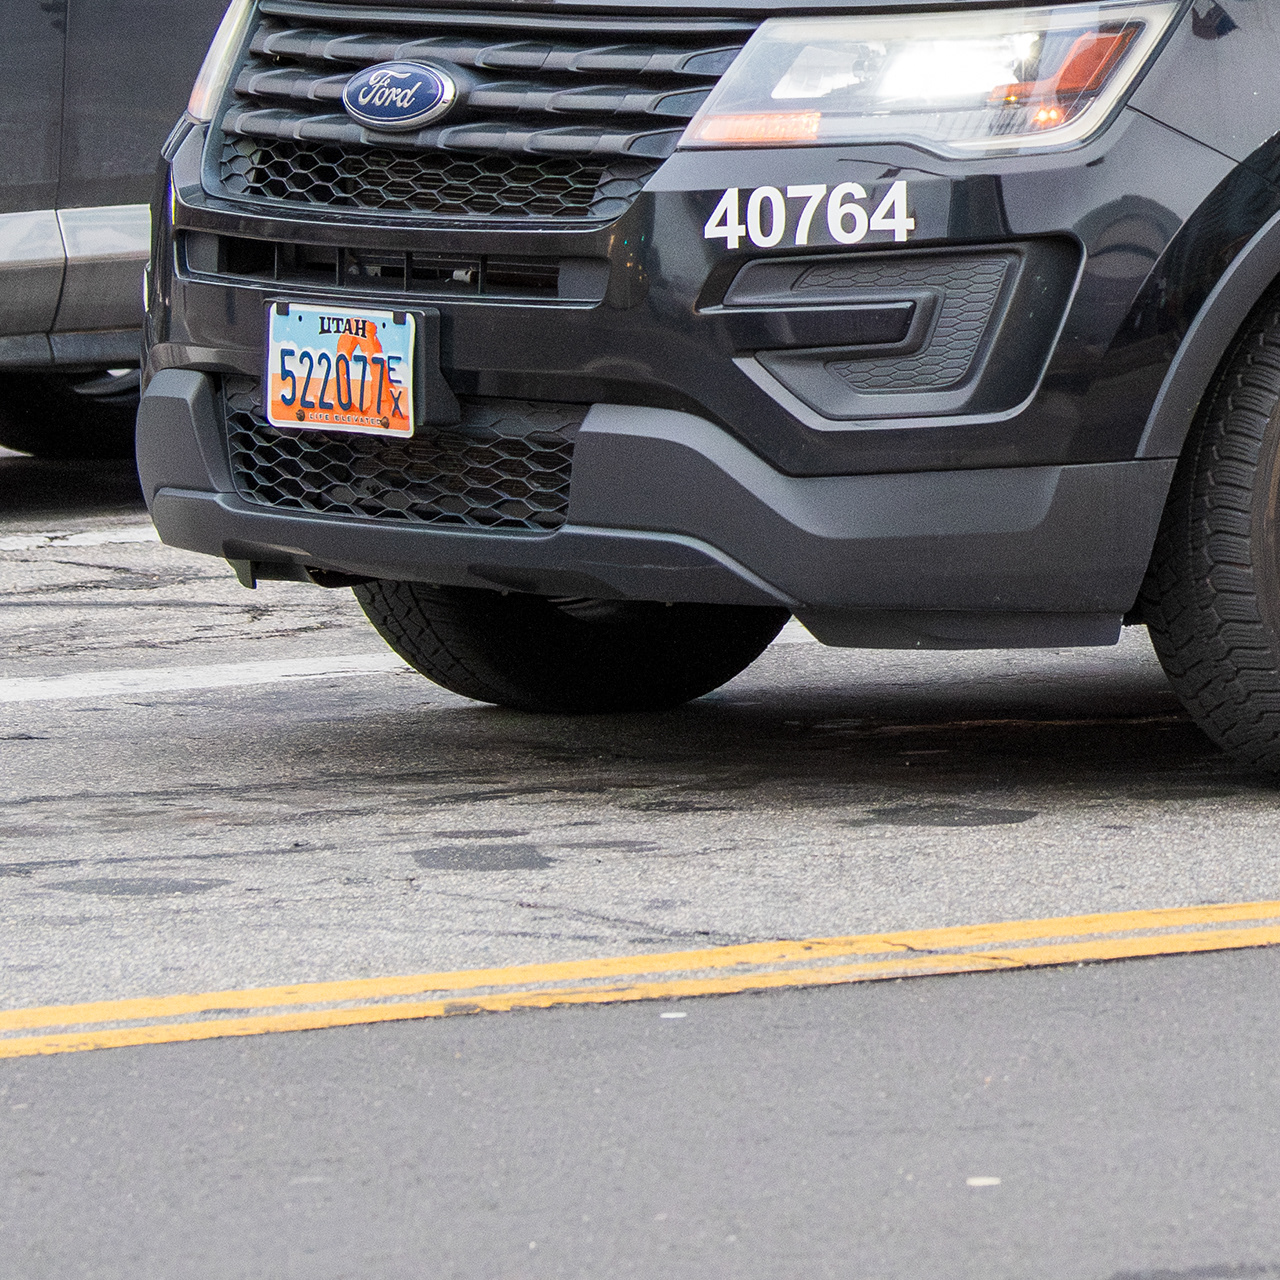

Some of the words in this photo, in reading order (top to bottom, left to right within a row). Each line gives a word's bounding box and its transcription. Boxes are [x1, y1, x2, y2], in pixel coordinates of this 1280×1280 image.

[358, 69, 423, 109] Ford
[703, 179, 916, 250] 40764
[318, 316, 367, 338] UTAH
[308, 411, 330, 421] LIFE
[333, 413, 381, 425] ELEVATED
